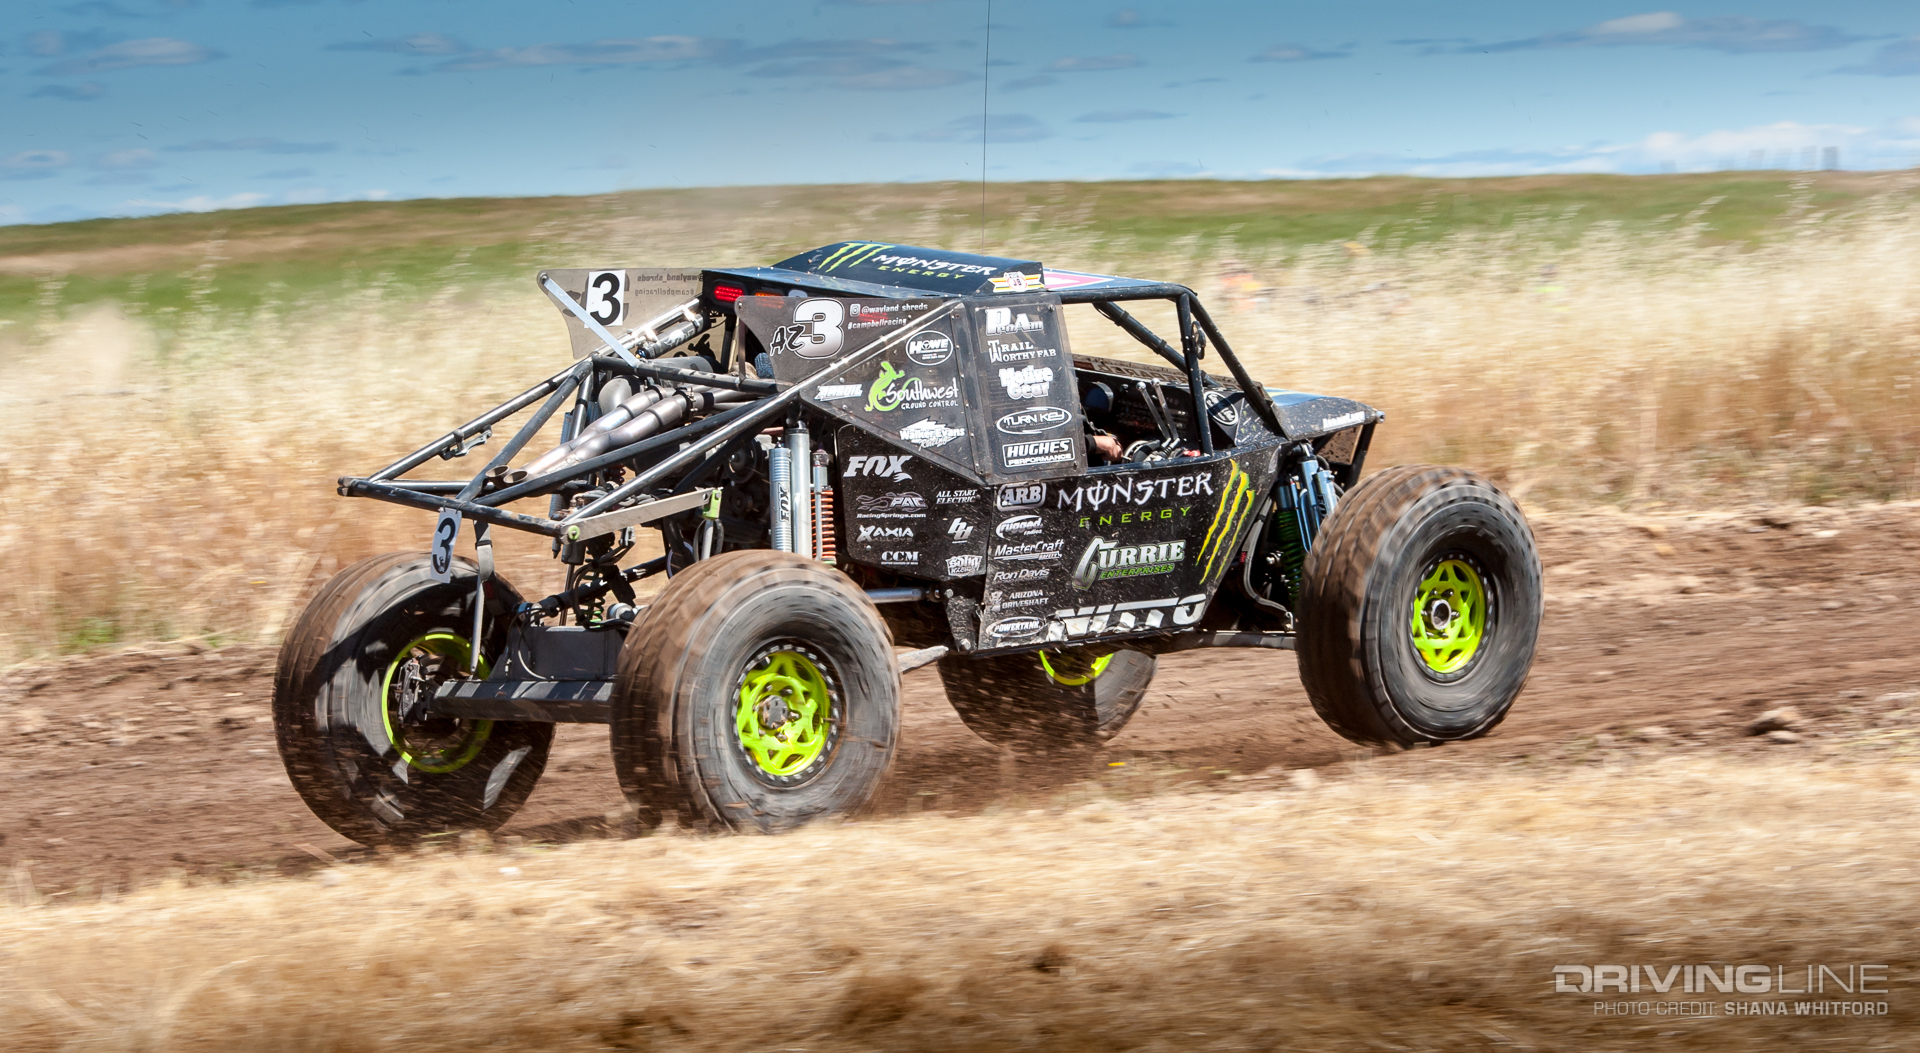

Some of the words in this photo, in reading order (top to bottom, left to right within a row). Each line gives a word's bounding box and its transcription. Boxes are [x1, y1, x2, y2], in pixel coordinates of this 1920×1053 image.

[872, 254, 997, 275] MONSTER
[877, 265, 965, 279] ENERGY
[590, 272, 621, 326] 3
[793, 298, 845, 359] 3
[770, 324, 805, 356] AZ
[909, 338, 949, 354] HOWE
[987, 340, 1034, 353] TRAIL
[988, 346, 1036, 363] WORTHY
[1036, 348, 1057, 358] FAB
[885, 377, 959, 403] Southwest
[1007, 380, 1050, 400] Gear
[901, 401, 927, 409] GROUND
[929, 400, 959, 408] CONTROL
[1003, 414, 1038, 426] TURN
[1039, 411, 1066, 422] KEY
[900, 429, 935, 440] Walker
[935, 428, 965, 438] Evans
[1007, 440, 1071, 458] HUGHES
[1008, 453, 1072, 466] PERFORMANCE
[843, 455, 912, 482] FOX
[936, 490, 952, 498] ALL
[952, 489, 978, 498] START
[936, 496, 976, 505] ELECTRIC
[1003, 485, 1042, 505] ARB
[1057, 472, 1214, 512] MONSTER
[778, 482, 790, 523] FOX
[890, 497, 928, 508] PAC
[1000, 517, 1043, 534] rugged
[1079, 506, 1192, 528] ENERGY
[873, 527, 914, 537] AXIA
[432, 517, 456, 574] 3
[994, 539, 1065, 556] MasterCraft
[881, 551, 919, 562] CCM
[1072, 535, 1187, 590] CURRIE
[994, 571, 1018, 581] Ron
[1019, 567, 1050, 578] Davis
[1099, 563, 1176, 580] ENTERPRISES
[1009, 589, 1044, 599] ARIZONA
[1002, 597, 1049, 609] DRIVESHAFT
